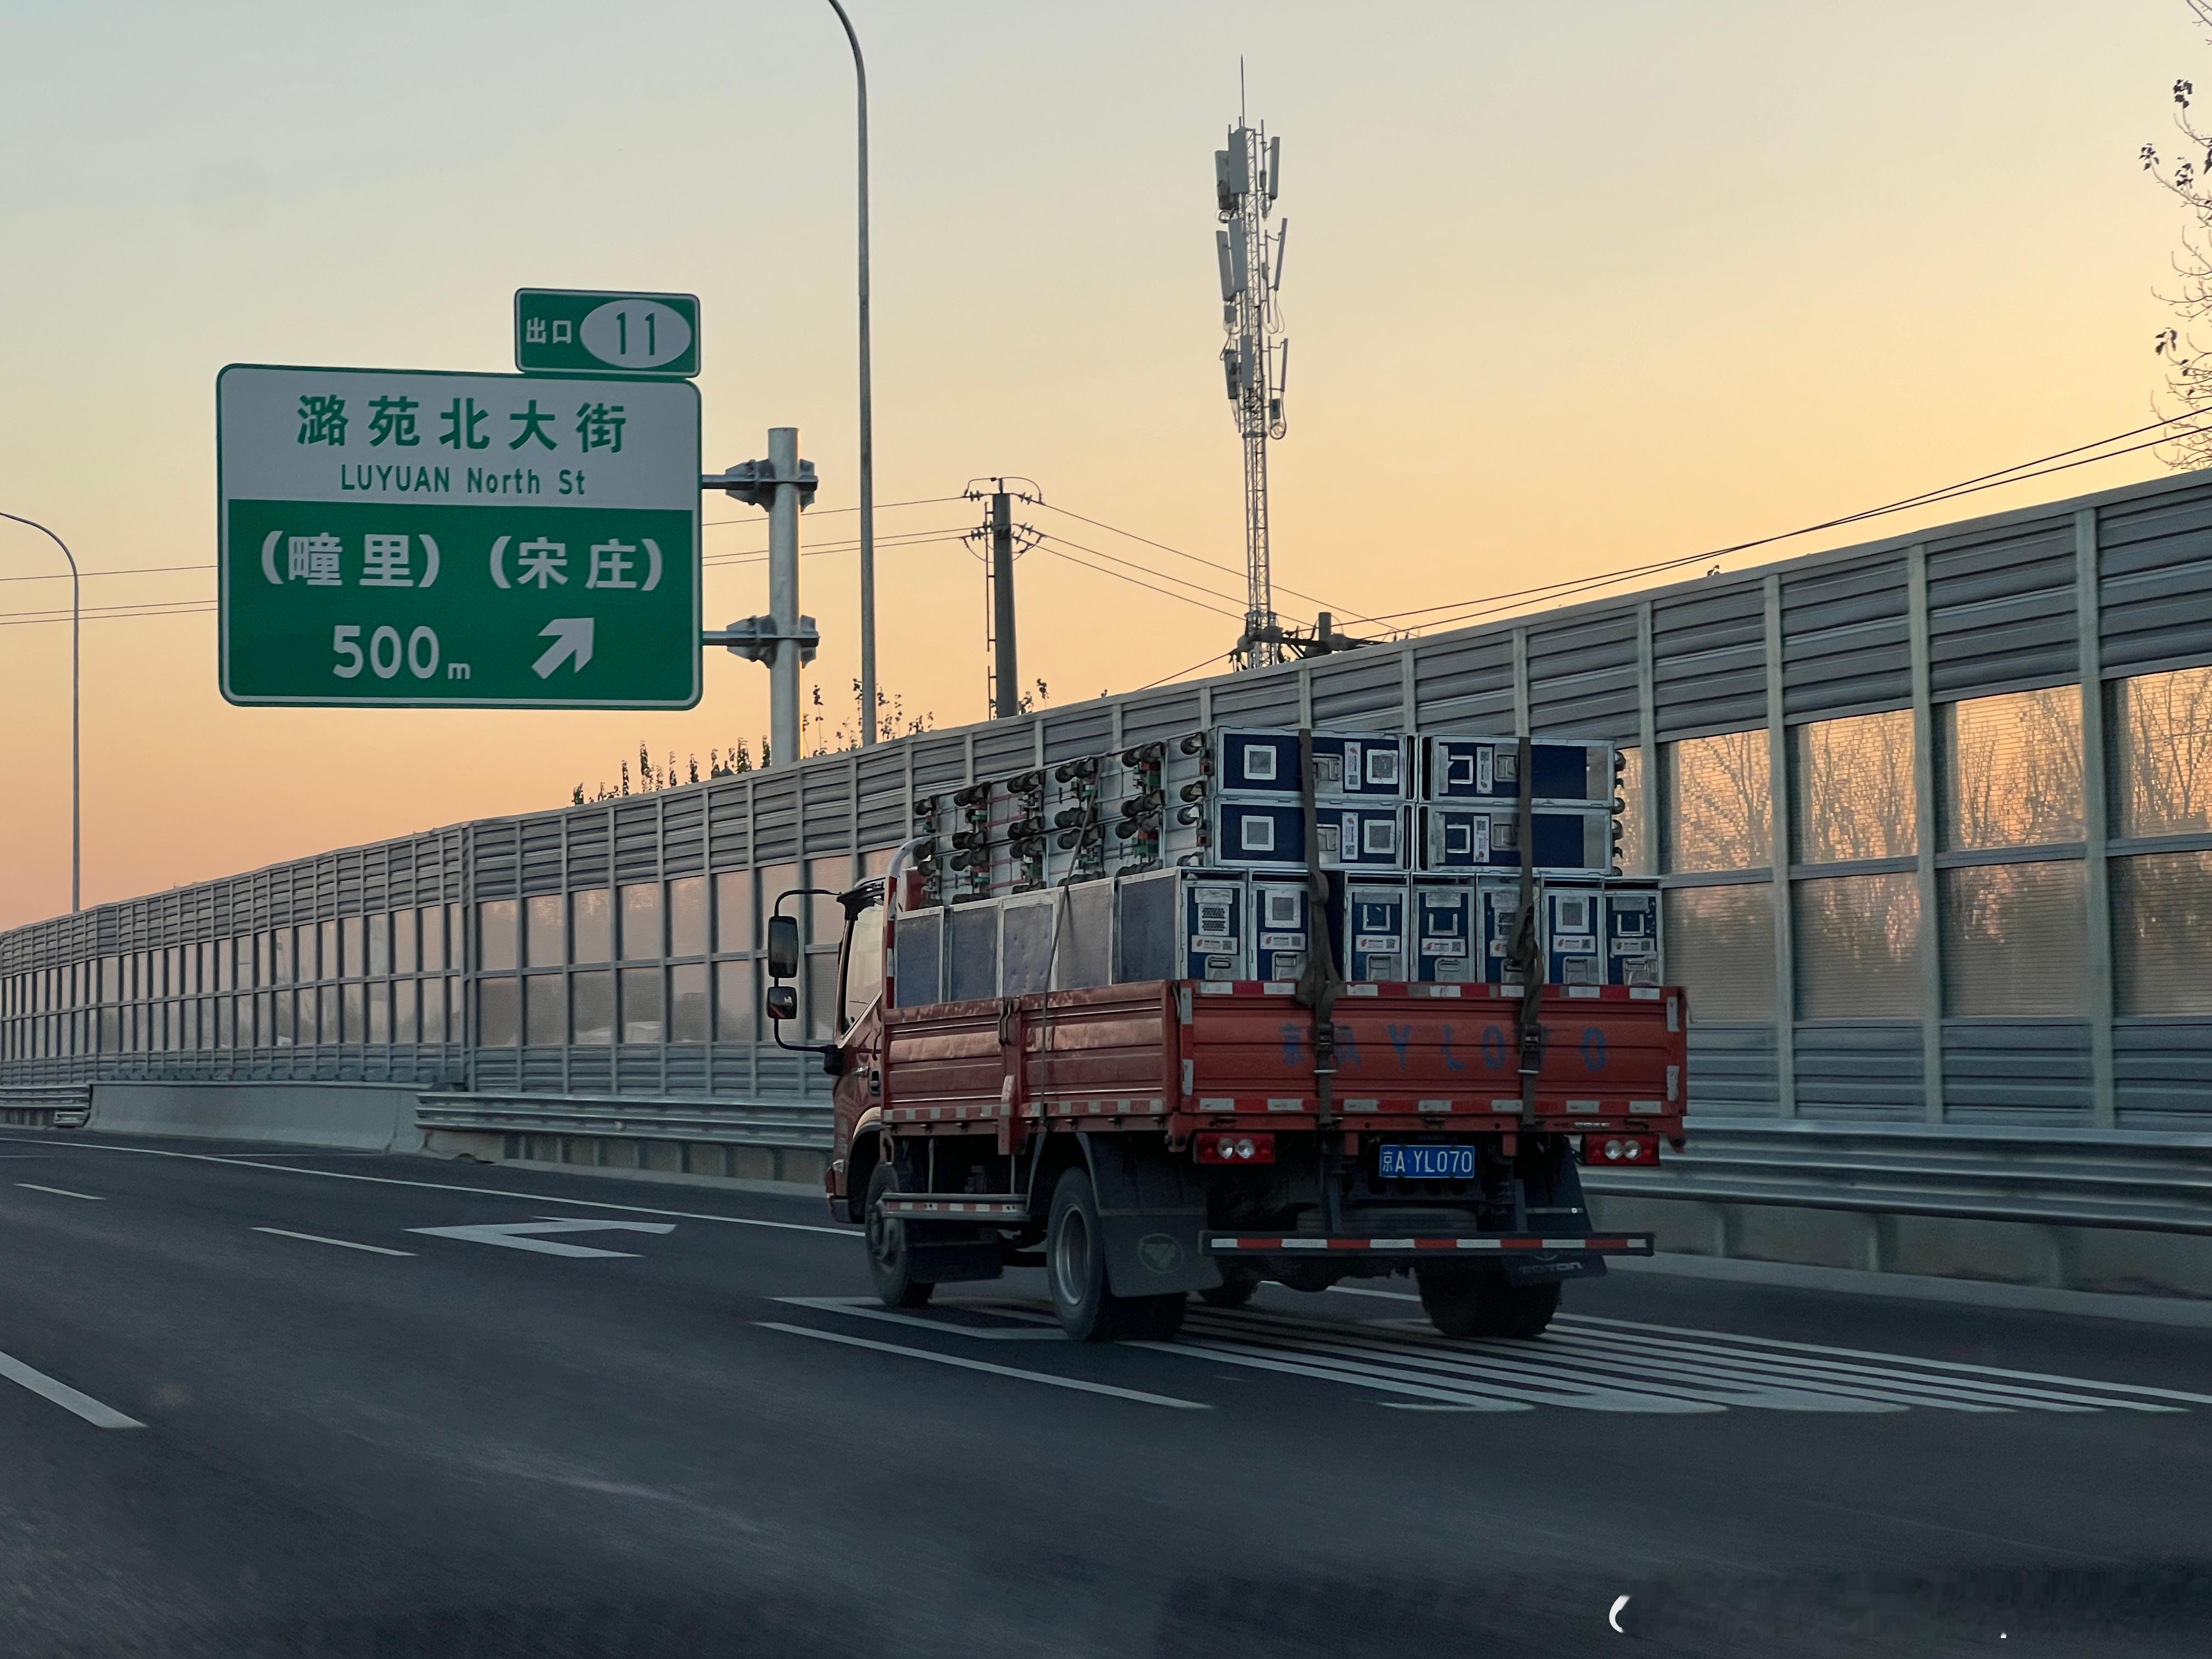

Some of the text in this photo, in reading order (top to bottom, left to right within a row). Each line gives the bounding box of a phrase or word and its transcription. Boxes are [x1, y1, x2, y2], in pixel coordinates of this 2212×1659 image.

[526, 312, 655, 356] 出口 11
[297, 394, 627, 453] 潞苑北大街
[341, 464, 585, 495] LUYUAN North St
